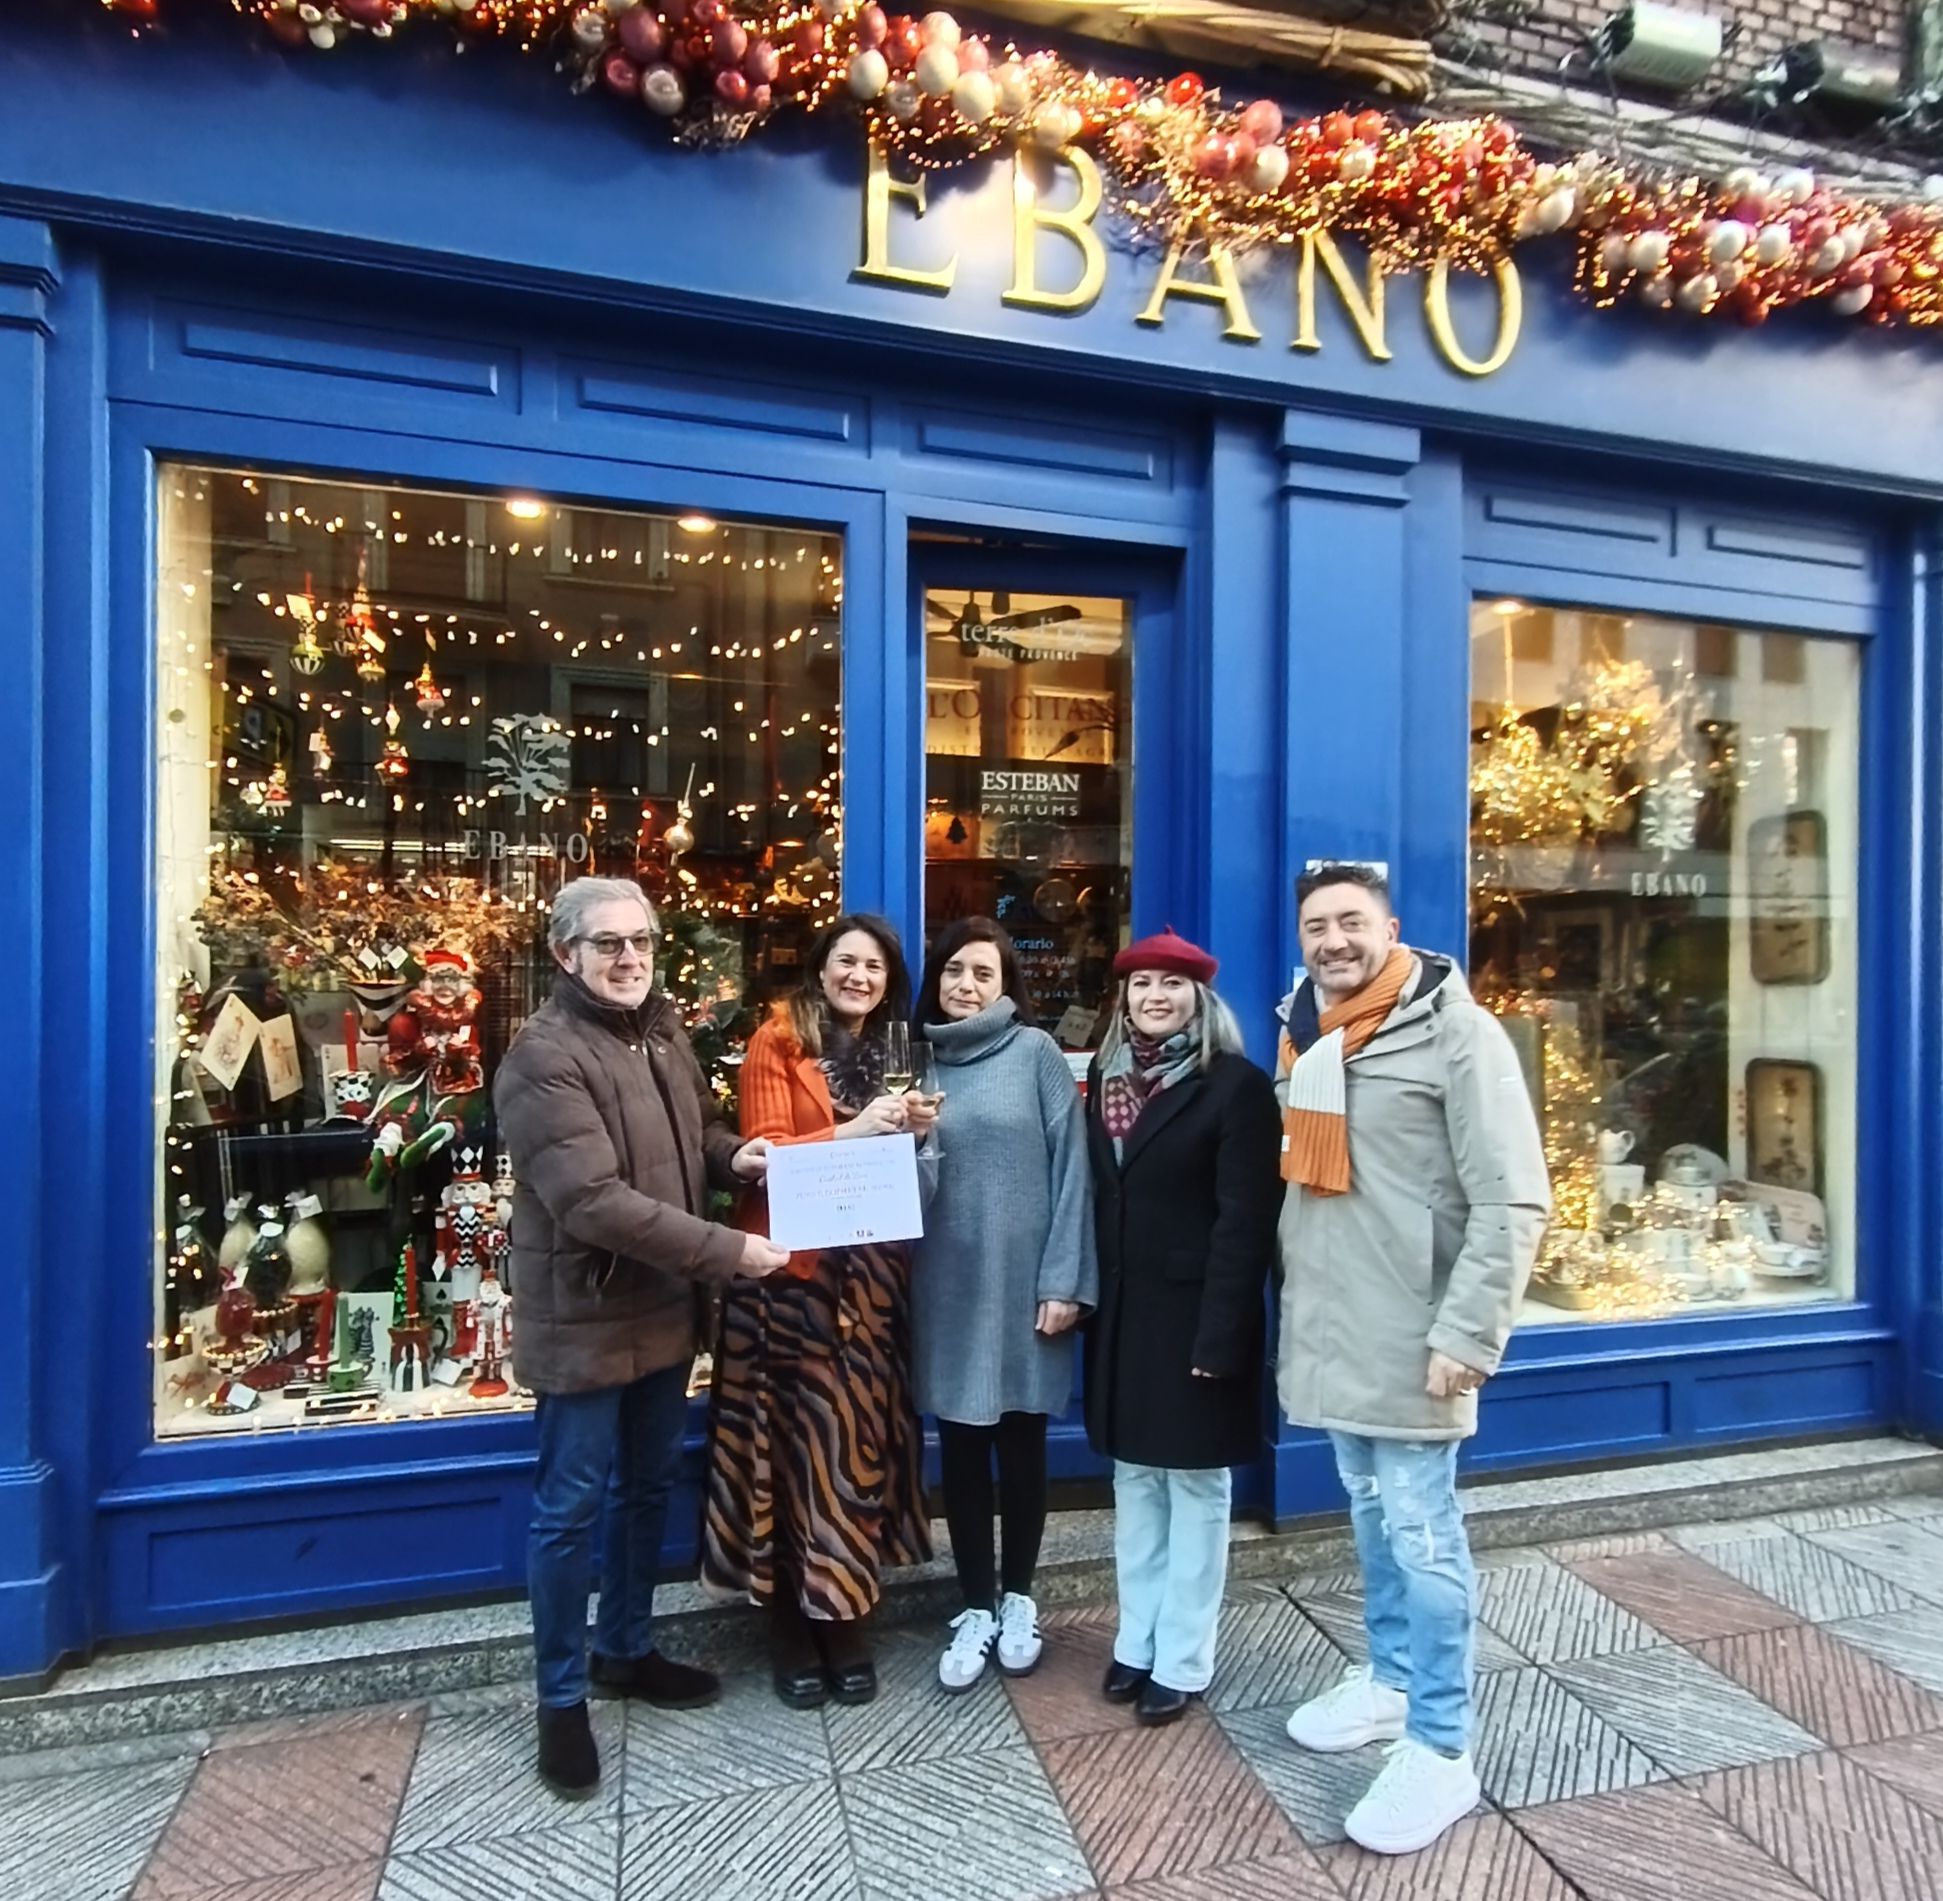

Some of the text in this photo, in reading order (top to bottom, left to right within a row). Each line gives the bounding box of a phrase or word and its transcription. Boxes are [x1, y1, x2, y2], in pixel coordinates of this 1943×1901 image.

[847, 140, 1523, 378] EBANO
[981, 771, 1080, 792] ESTEBAN
[1010, 793, 1048, 802] PARIS
[981, 803, 1078, 816] PARFUMS
[463, 829, 588, 863] EBANO
[1631, 872, 1707, 897] EBANO
[1009, 936, 1054, 949] orario
